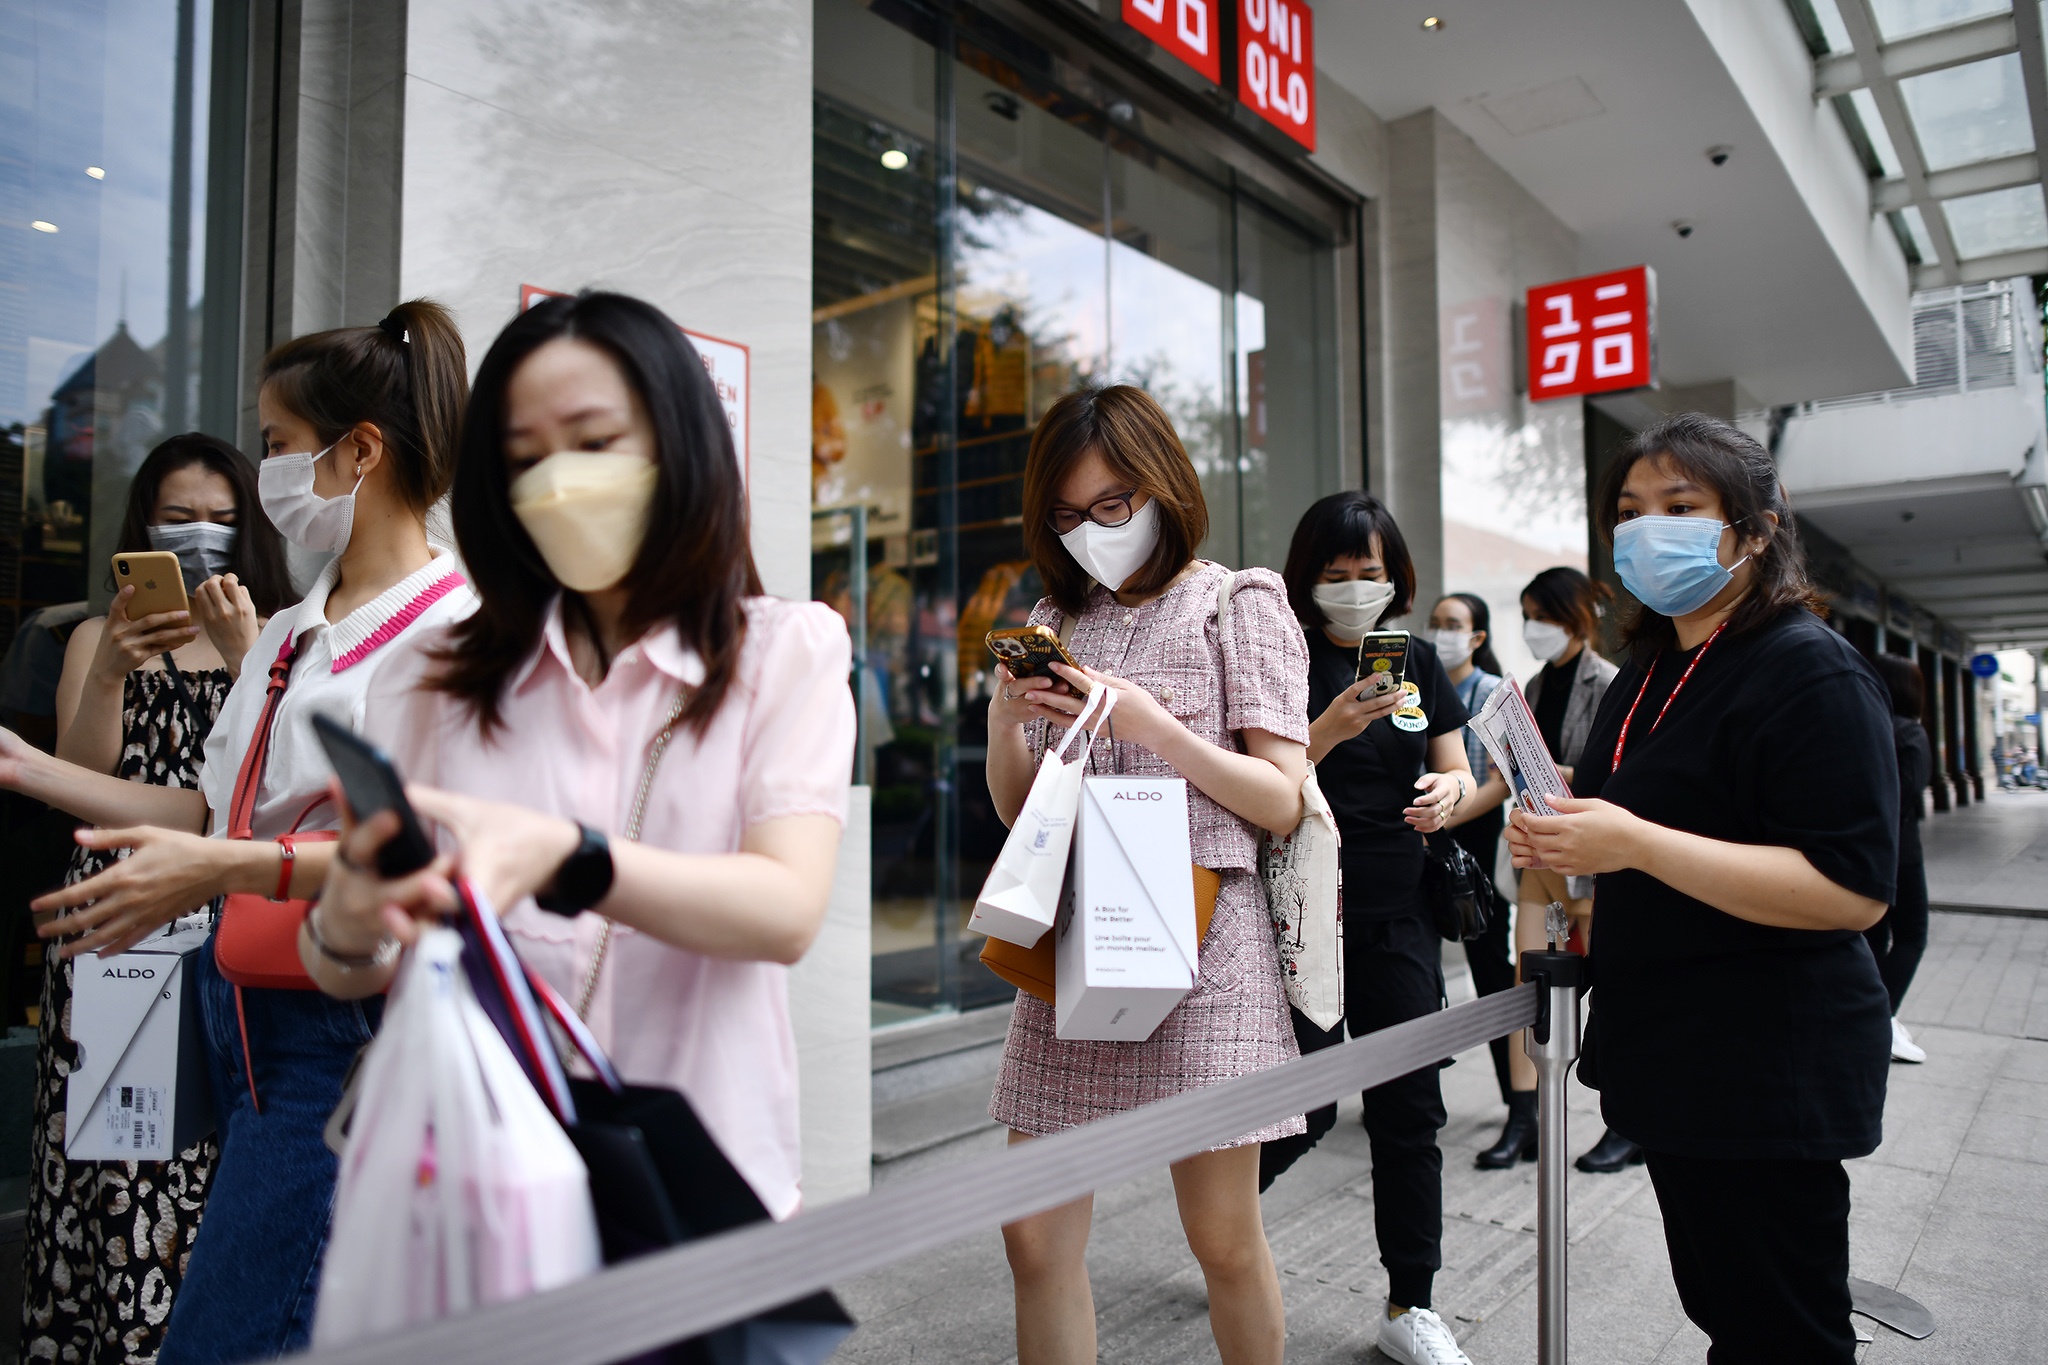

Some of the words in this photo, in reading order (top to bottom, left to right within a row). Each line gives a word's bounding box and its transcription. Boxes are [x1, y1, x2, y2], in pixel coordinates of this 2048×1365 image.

[1245, 0, 1302, 64] UNI
[1246, 40, 1308, 125] QLO
[1541, 283, 1633, 339] ユニ
[1539, 331, 1634, 388] クロ
[1113, 791, 1163, 802] ALDO
[102, 968, 156, 979] ALDO
